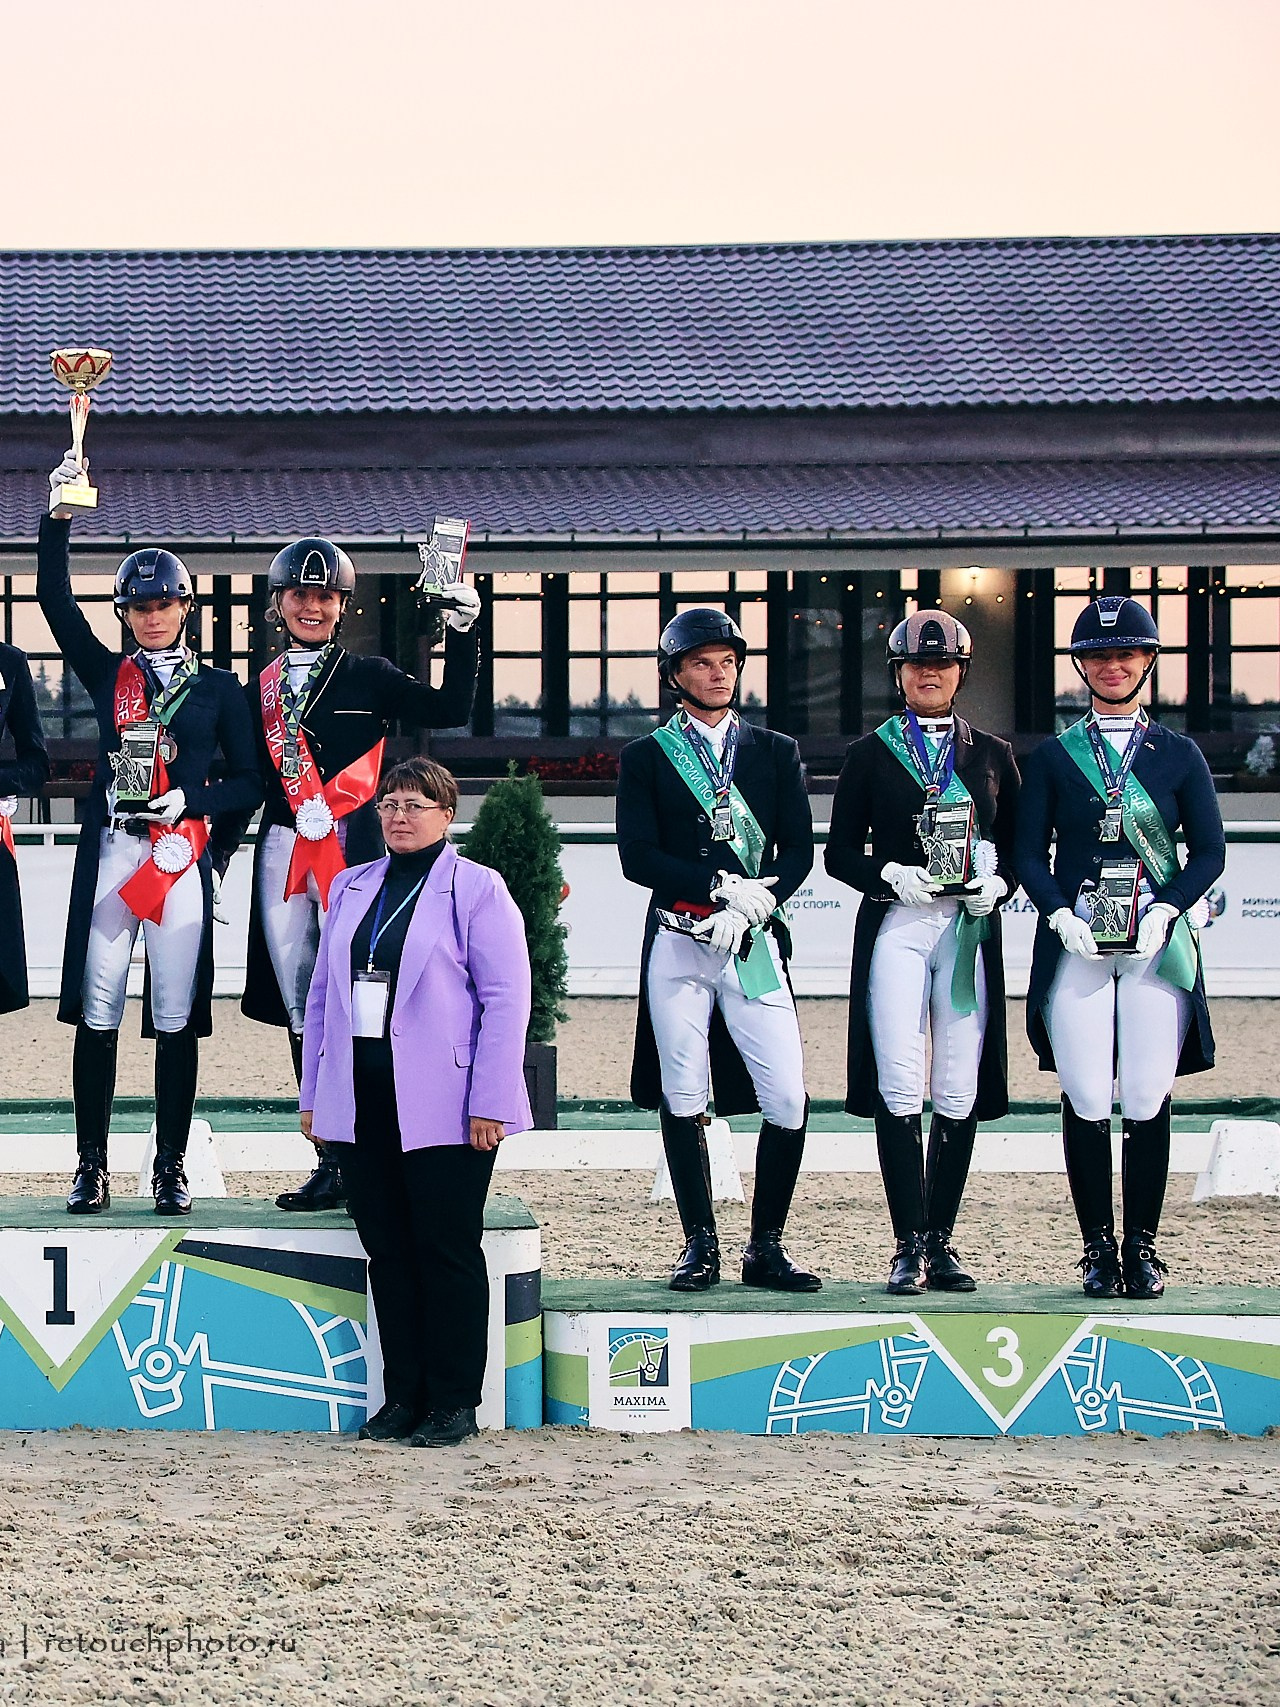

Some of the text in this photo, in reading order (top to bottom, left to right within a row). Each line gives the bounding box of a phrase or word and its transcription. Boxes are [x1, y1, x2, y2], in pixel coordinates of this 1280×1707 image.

[699, 781, 714, 801] ПО
[803, 900, 841, 909] СПОРТА
[44, 1247, 75, 1325] 1
[982, 1326, 1024, 1387] 3
[613, 1396, 667, 1406] MAXIMA
